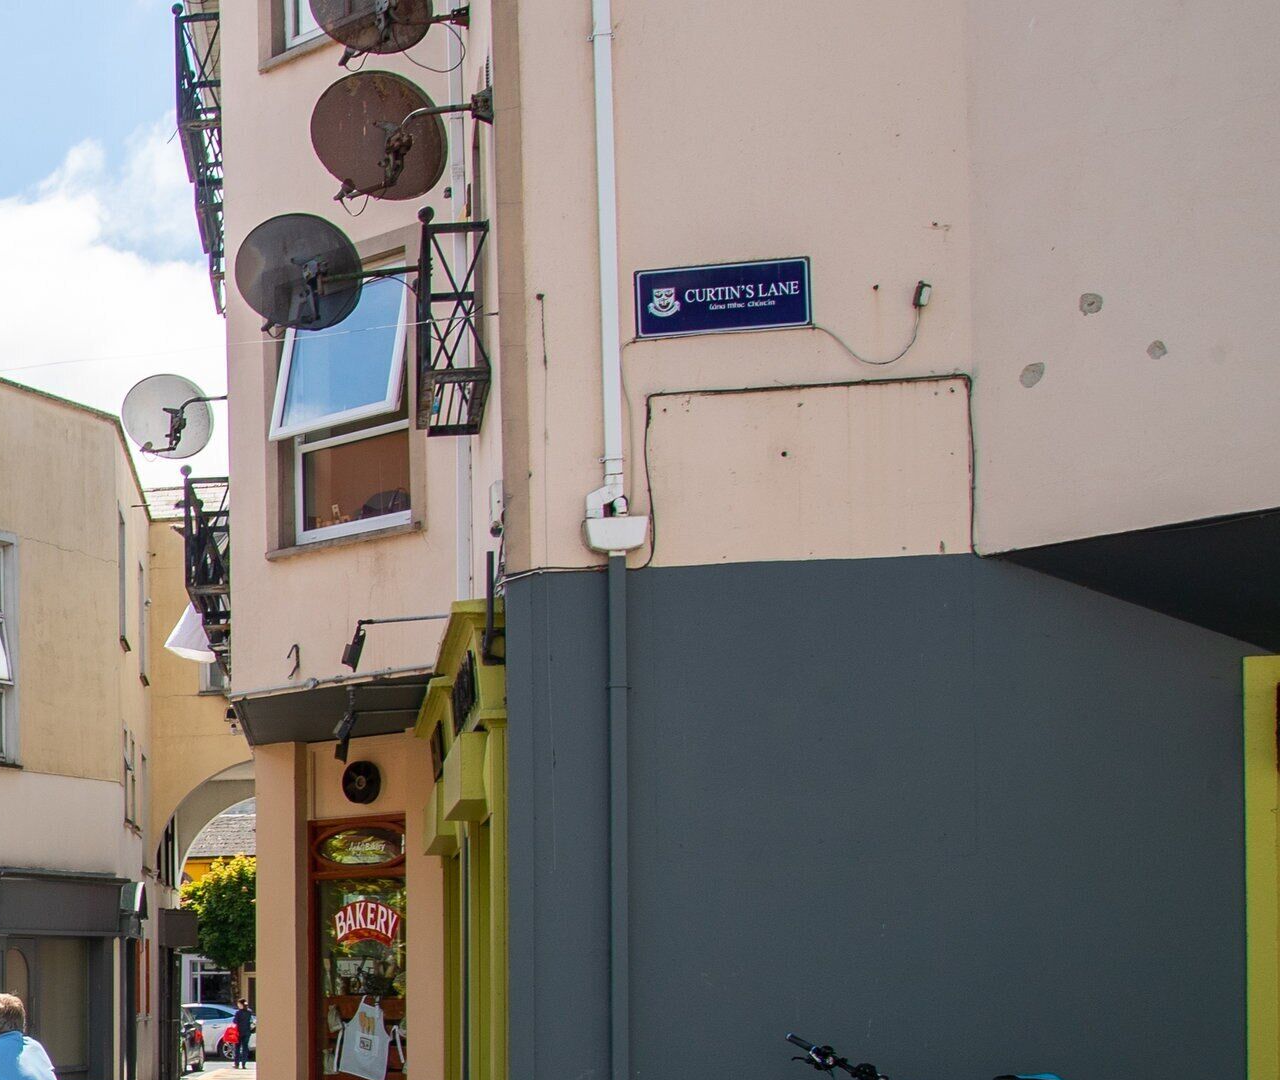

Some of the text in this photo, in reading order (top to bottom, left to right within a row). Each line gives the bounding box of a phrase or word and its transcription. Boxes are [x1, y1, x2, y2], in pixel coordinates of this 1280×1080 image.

[684, 280, 800, 303] CURTIN'S LANE
[334, 901, 398, 940] BAKERY
